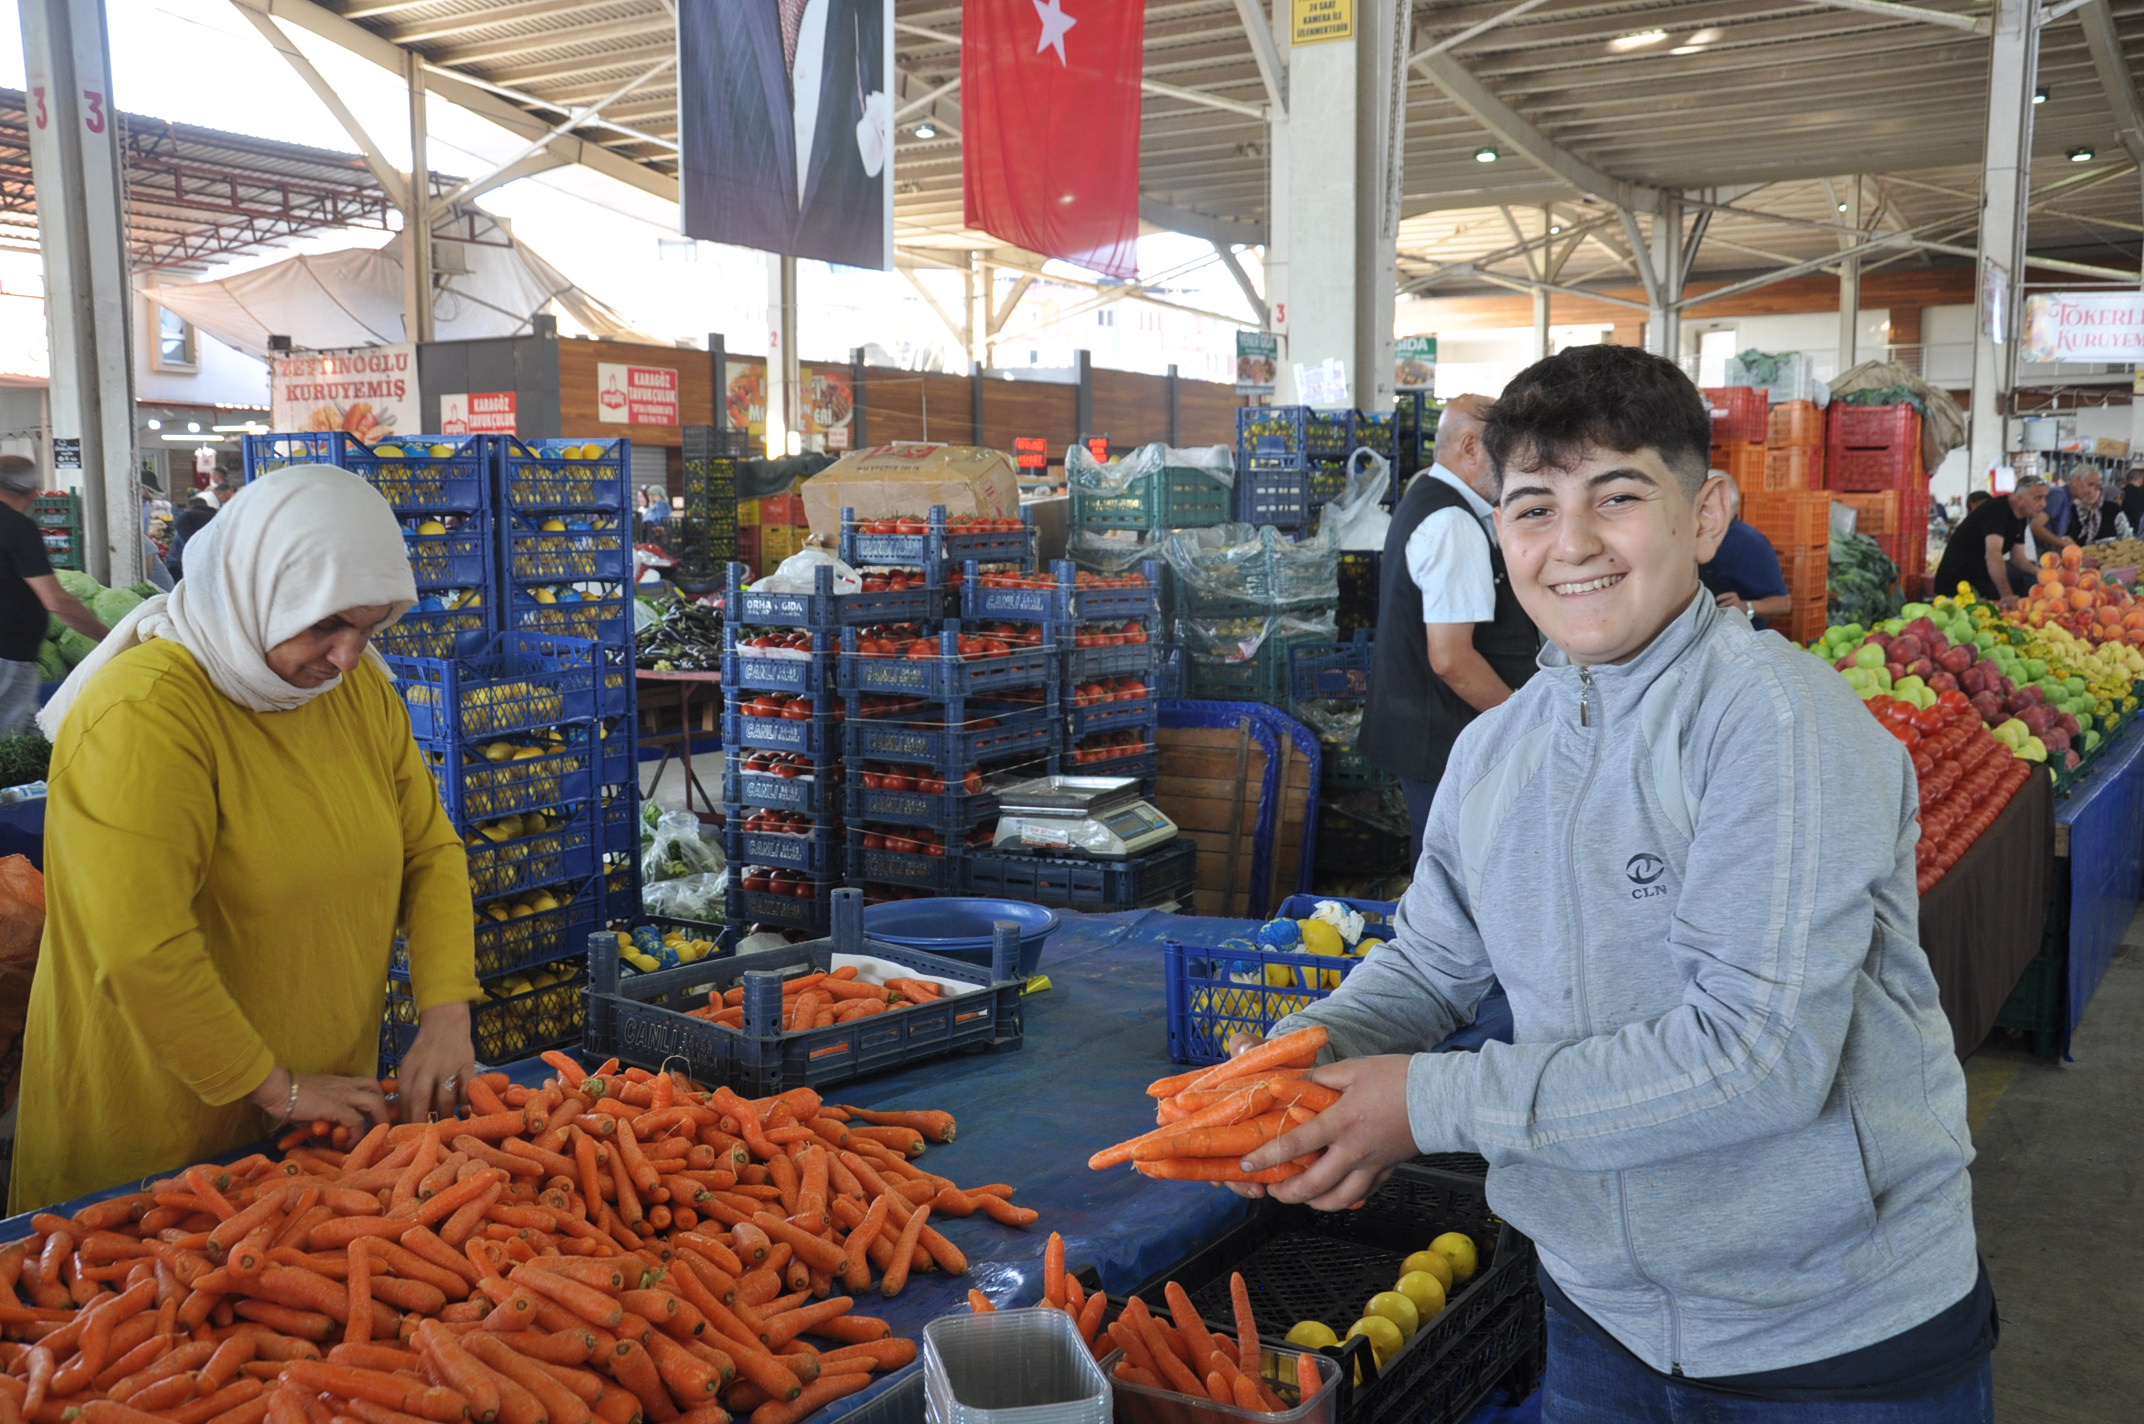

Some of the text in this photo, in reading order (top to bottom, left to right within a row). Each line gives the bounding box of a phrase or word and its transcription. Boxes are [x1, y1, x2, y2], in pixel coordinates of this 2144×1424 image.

[33, 87, 48, 130] 3
[84, 90, 105, 134] 3
[1276, 304, 1286, 323] 3
[770, 331, 778, 348] 2
[286, 374, 406, 402] KURUYEMİŞ
[633, 371, 671, 388] KARAGÖZ
[473, 394, 511, 412] KARAGÖZ
[1632, 885, 1667, 899] CLN
[624, 1018, 677, 1056] CANLI
